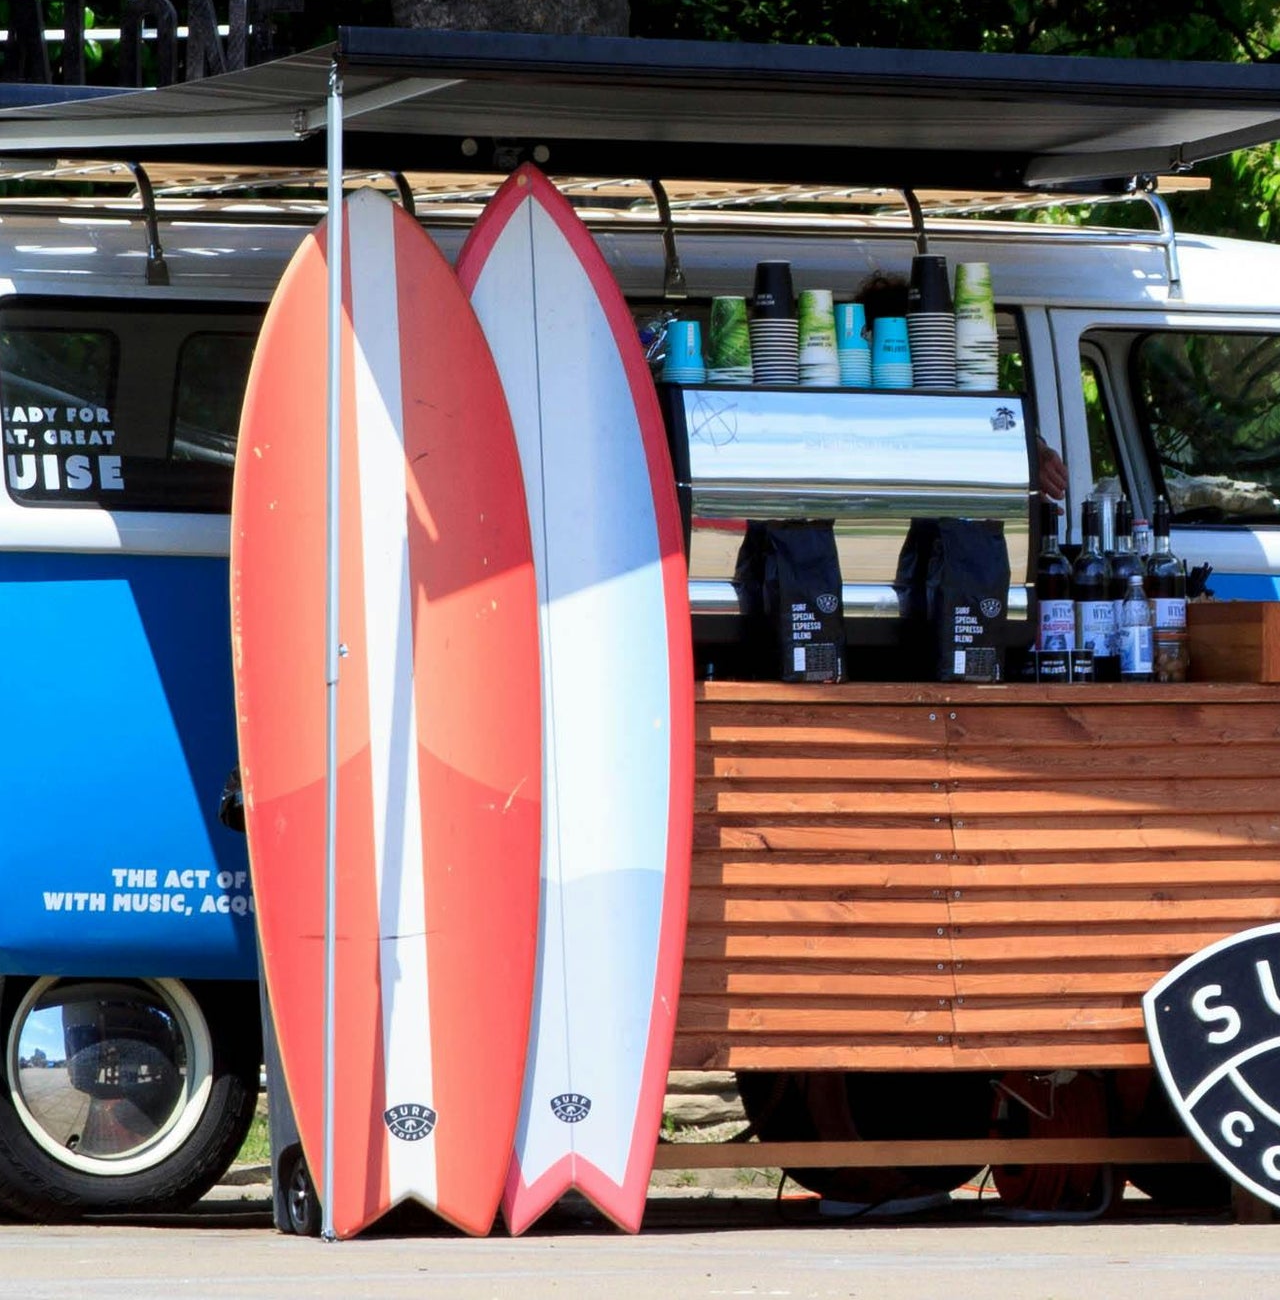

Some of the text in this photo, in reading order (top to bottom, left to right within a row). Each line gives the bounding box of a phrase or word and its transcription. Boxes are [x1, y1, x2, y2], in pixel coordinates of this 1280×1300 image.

[3, 406, 57, 423] ADY
[67, 407, 110, 423] FOR
[43, 429, 116, 446] GREAT
[112, 869, 247, 889] THE ACT OF
[43, 892, 106, 912] WITH
[112, 893, 192, 916] MUSIC,
[554, 1095, 587, 1107] SURF
[389, 1106, 431, 1120] SURF
[393, 1126, 429, 1140] COFFEE
